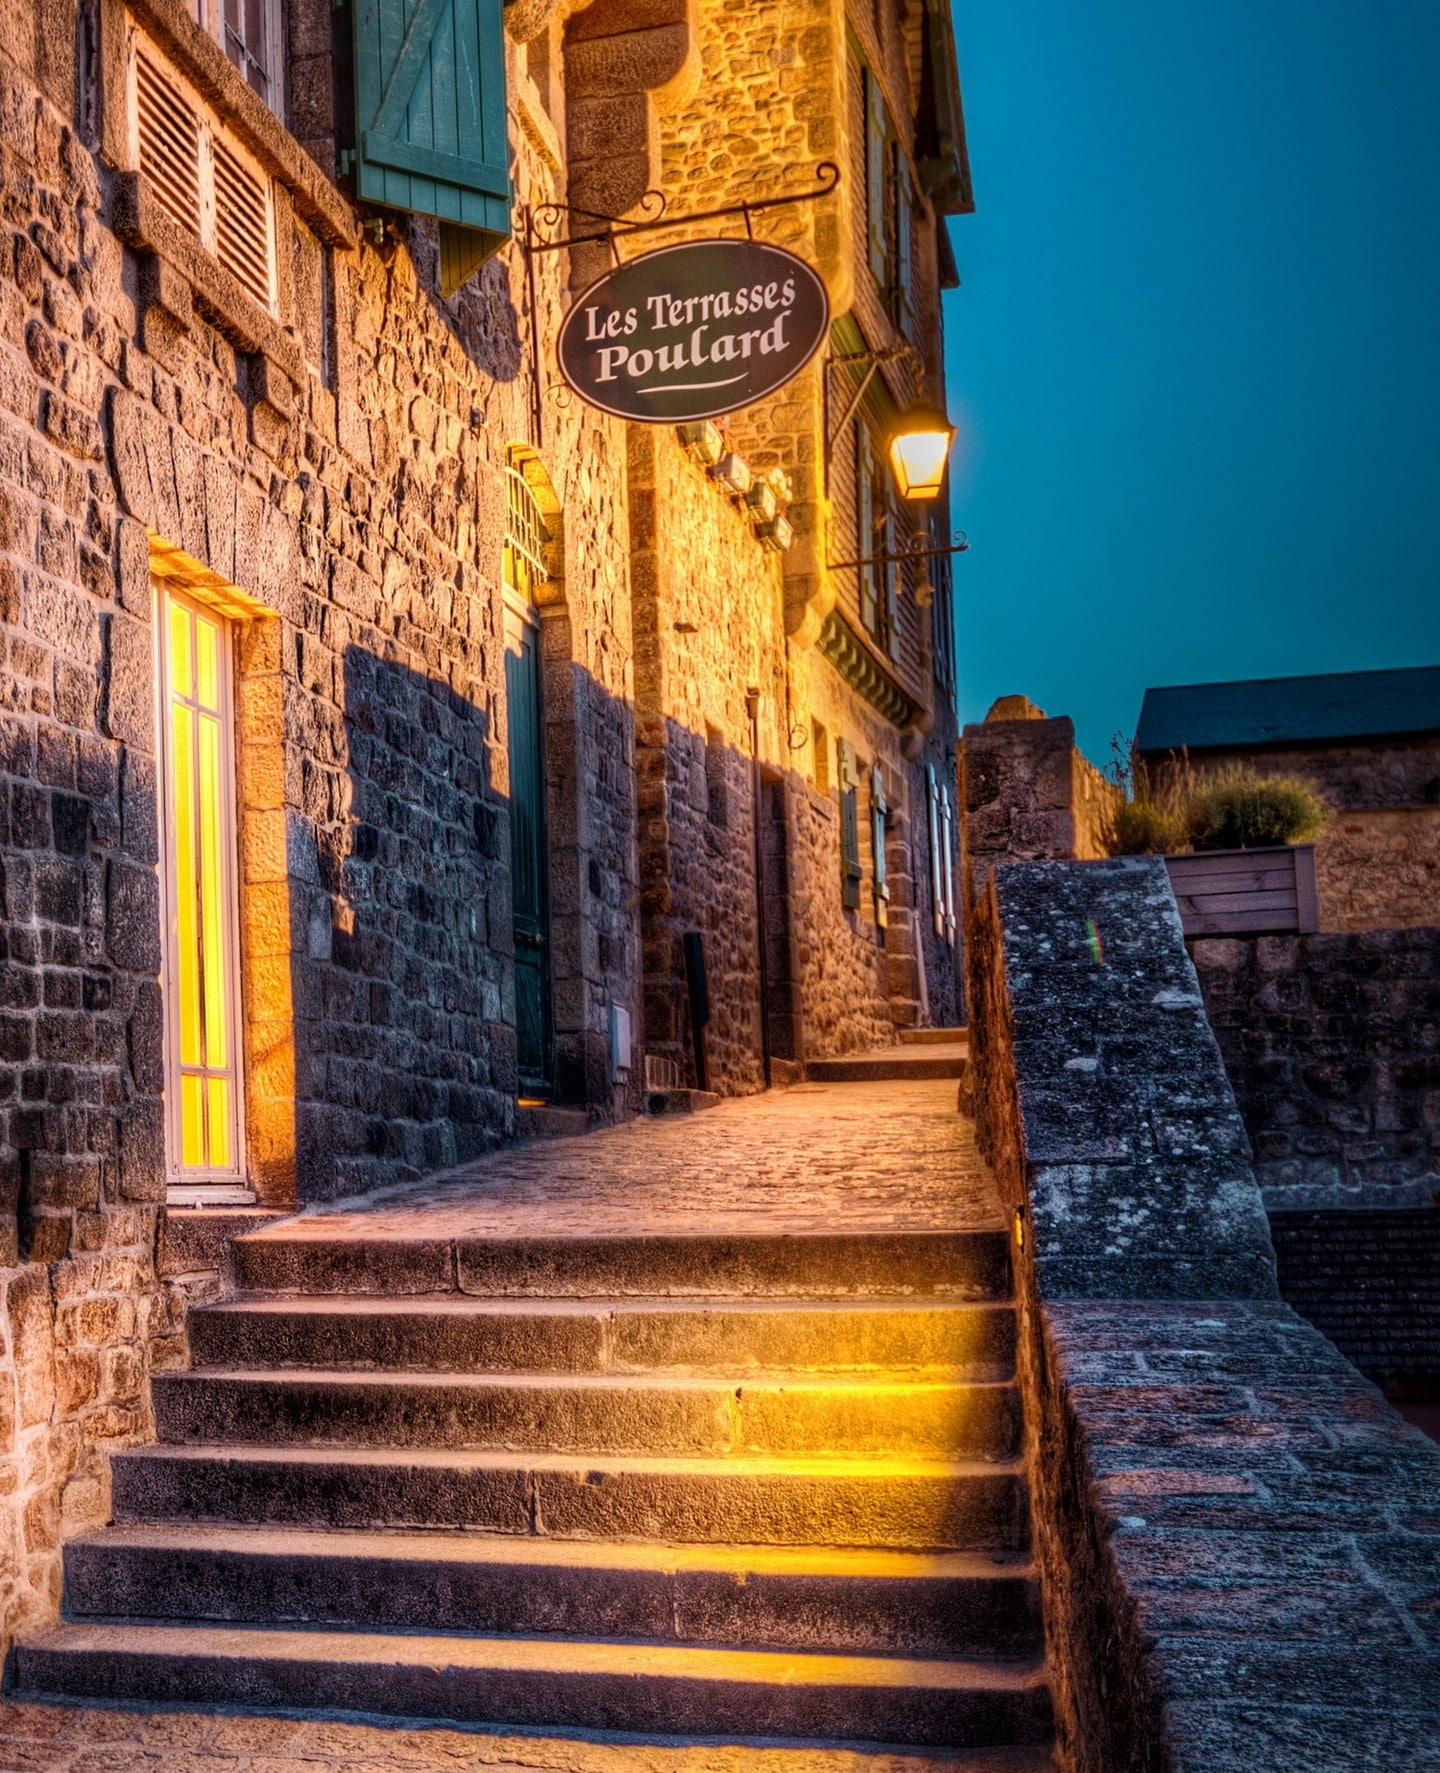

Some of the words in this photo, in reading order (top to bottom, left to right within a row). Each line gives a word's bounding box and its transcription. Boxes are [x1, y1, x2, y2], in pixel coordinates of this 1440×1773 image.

[585, 306, 638, 341] Les
[647, 278, 796, 330] Terrasses
[595, 310, 792, 383] Poulard
